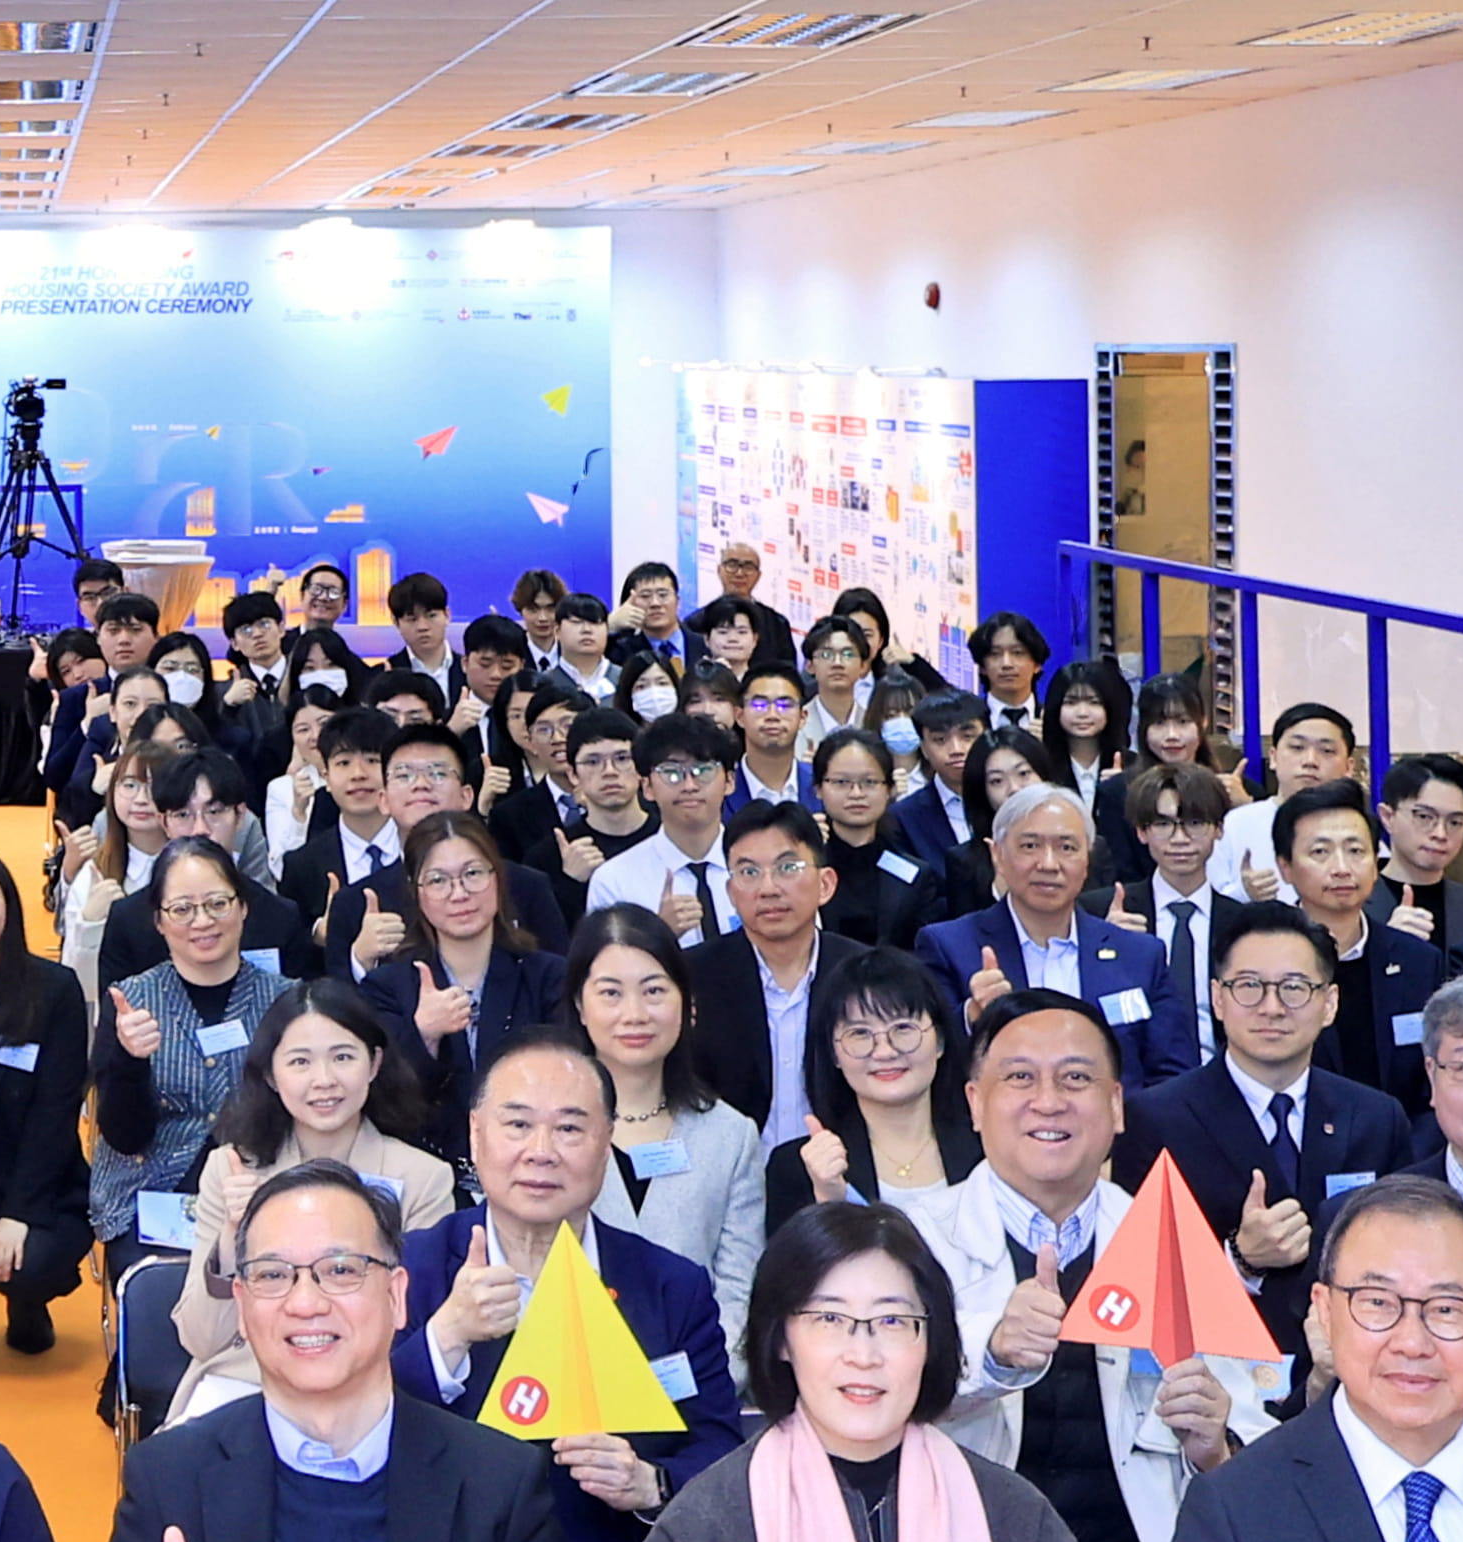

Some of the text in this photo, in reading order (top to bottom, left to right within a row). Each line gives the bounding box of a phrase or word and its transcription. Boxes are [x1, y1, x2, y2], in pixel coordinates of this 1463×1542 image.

[3, 281, 250, 298] HOUSING SOCIETY AWARD
[0, 298, 140, 315] PRESENTATION
[145, 298, 253, 315] CEREMONY
